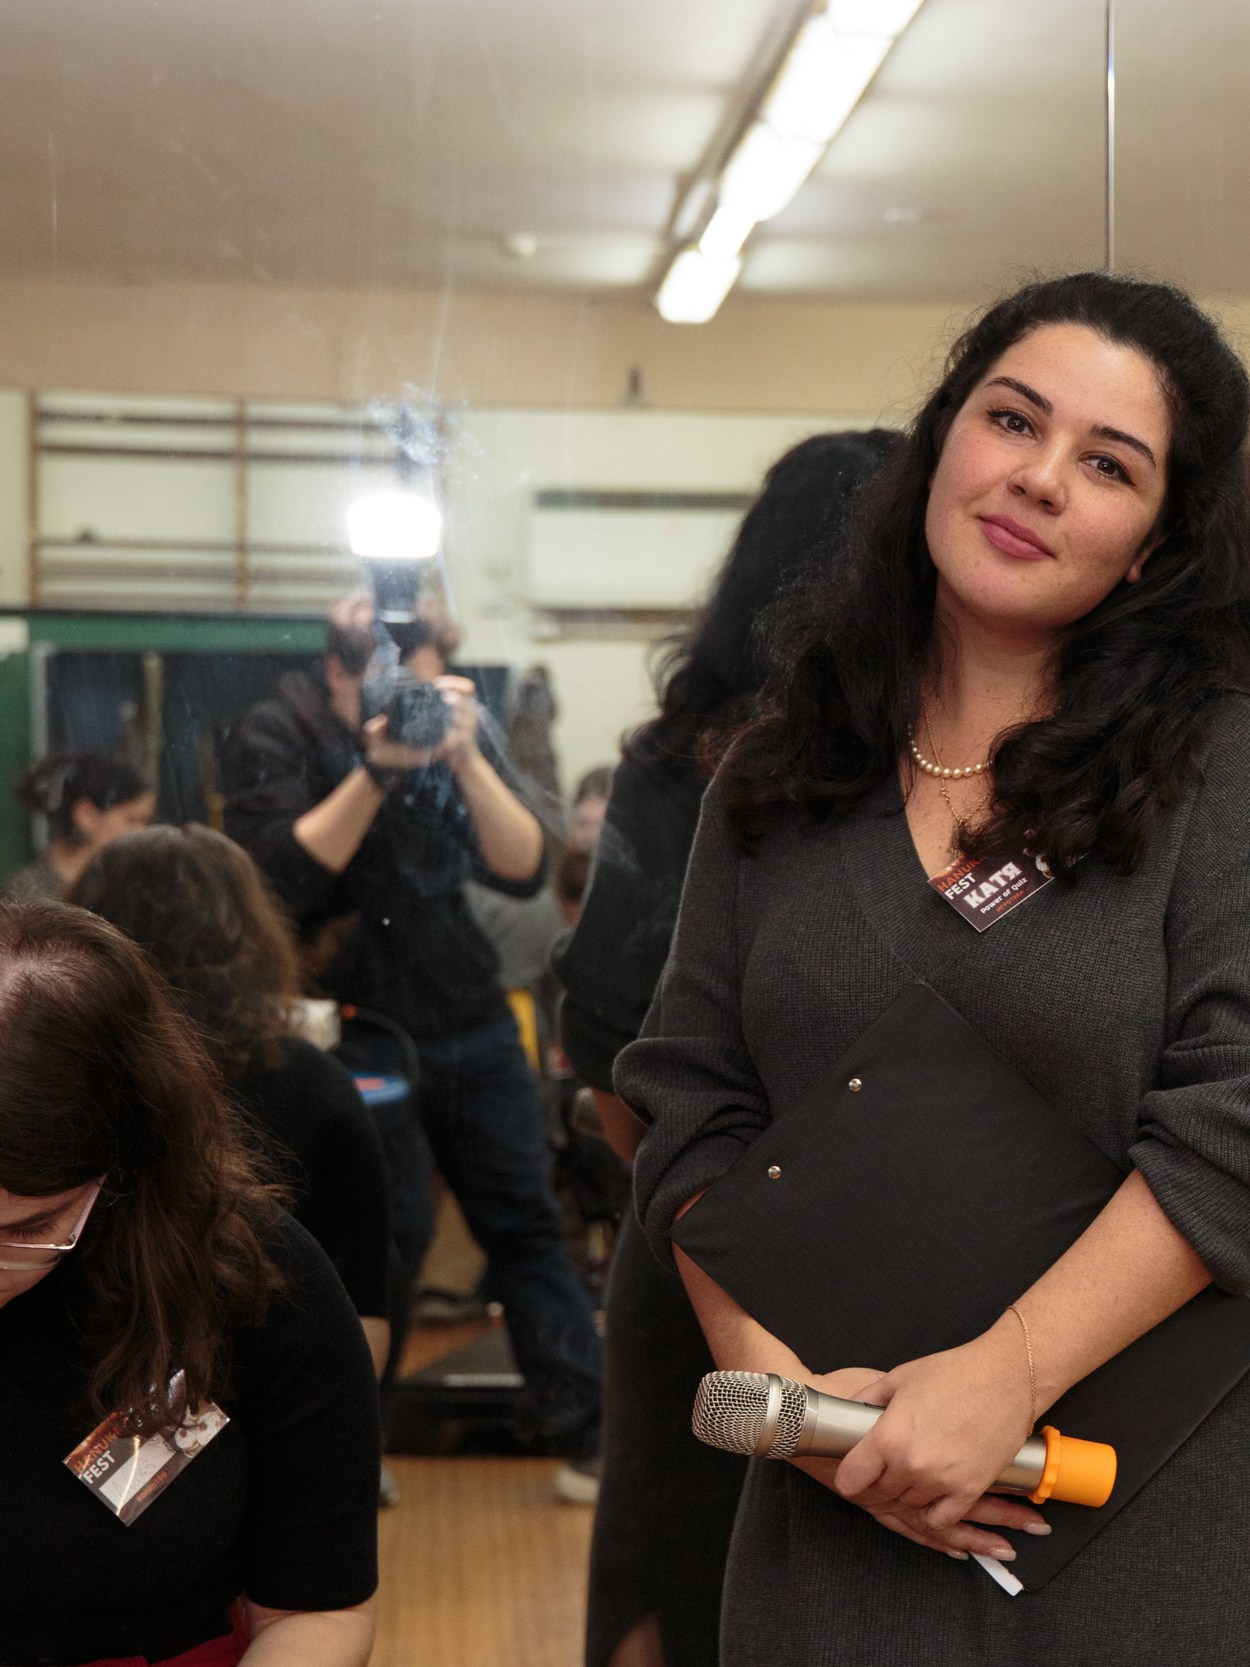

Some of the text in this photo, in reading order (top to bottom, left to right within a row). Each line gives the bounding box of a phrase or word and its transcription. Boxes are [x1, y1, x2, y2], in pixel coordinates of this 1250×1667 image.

[944, 872, 977, 900] FEST
[963, 861, 1022, 909] КАТЯ
[980, 896, 1003, 914] Power
[1011, 877, 1028, 891] Quiz
[82, 1450, 116, 1484] FEST
